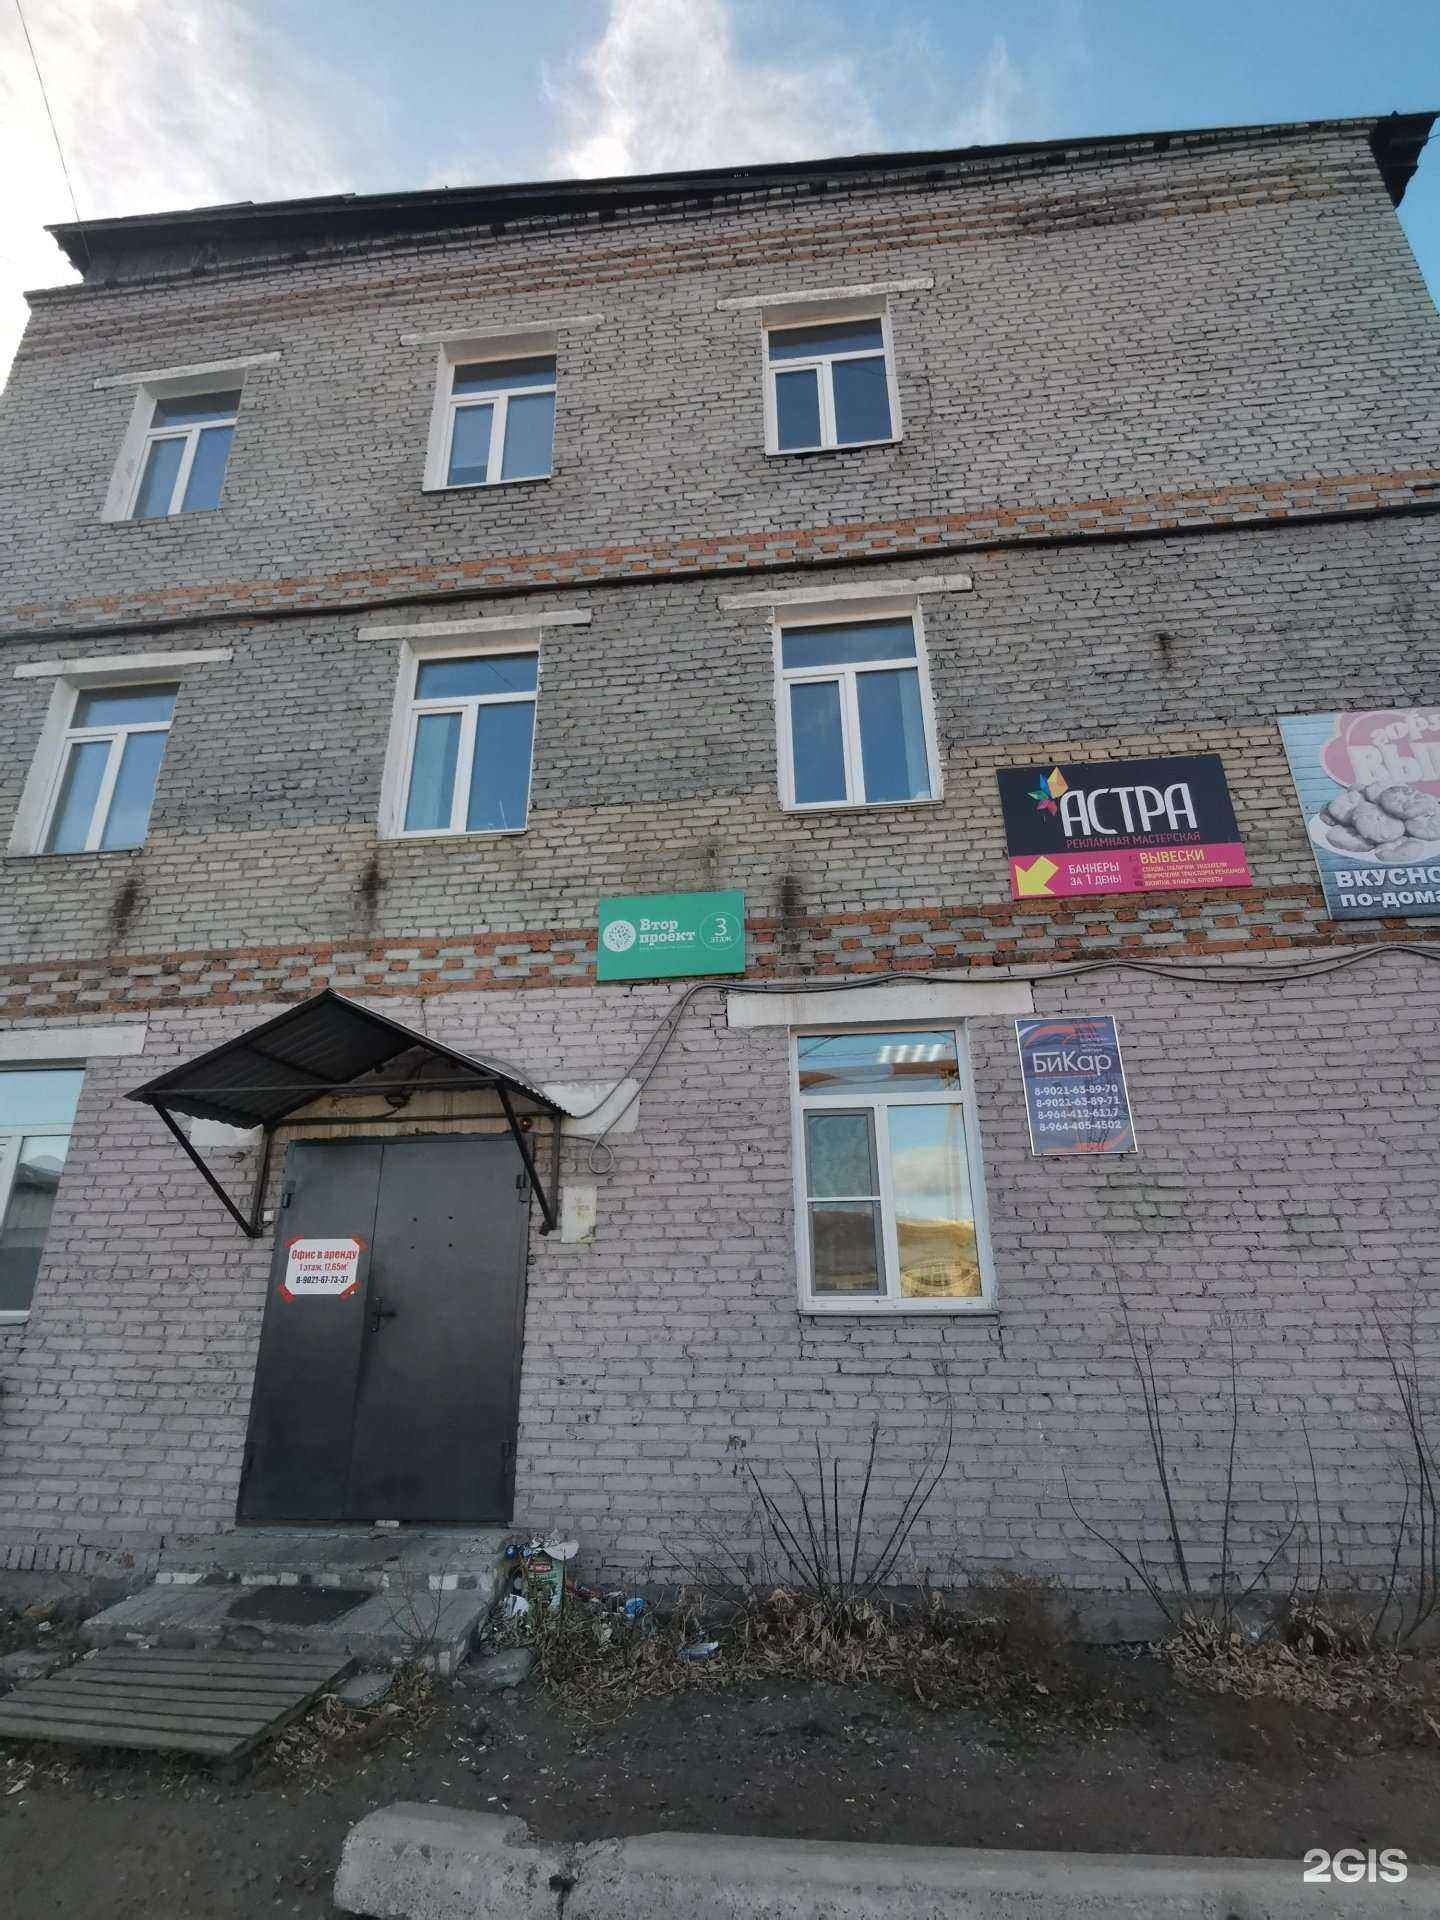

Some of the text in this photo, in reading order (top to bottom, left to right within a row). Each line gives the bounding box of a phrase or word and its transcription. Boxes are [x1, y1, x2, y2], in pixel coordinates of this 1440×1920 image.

[1059, 782, 1199, 837] АСТРА
[1066, 831, 1201, 849] РЕКЛАМНАЯ МАСТЕРСКАЯ
[1139, 849, 1206, 864] ВЫВЕСКИ
[1068, 861, 1120, 874] БАННЕРЫ
[1070, 877, 1083, 886] ЗА
[1085, 874, 1092, 885] 1
[640, 918, 678, 932] Втор
[714, 917, 728, 937] 3
[640, 931, 695, 946] проект
[1032, 1050, 1112, 1076] БиКар
[291, 1249, 316, 1260] Офис
[324, 1250, 358, 1259] аренду
